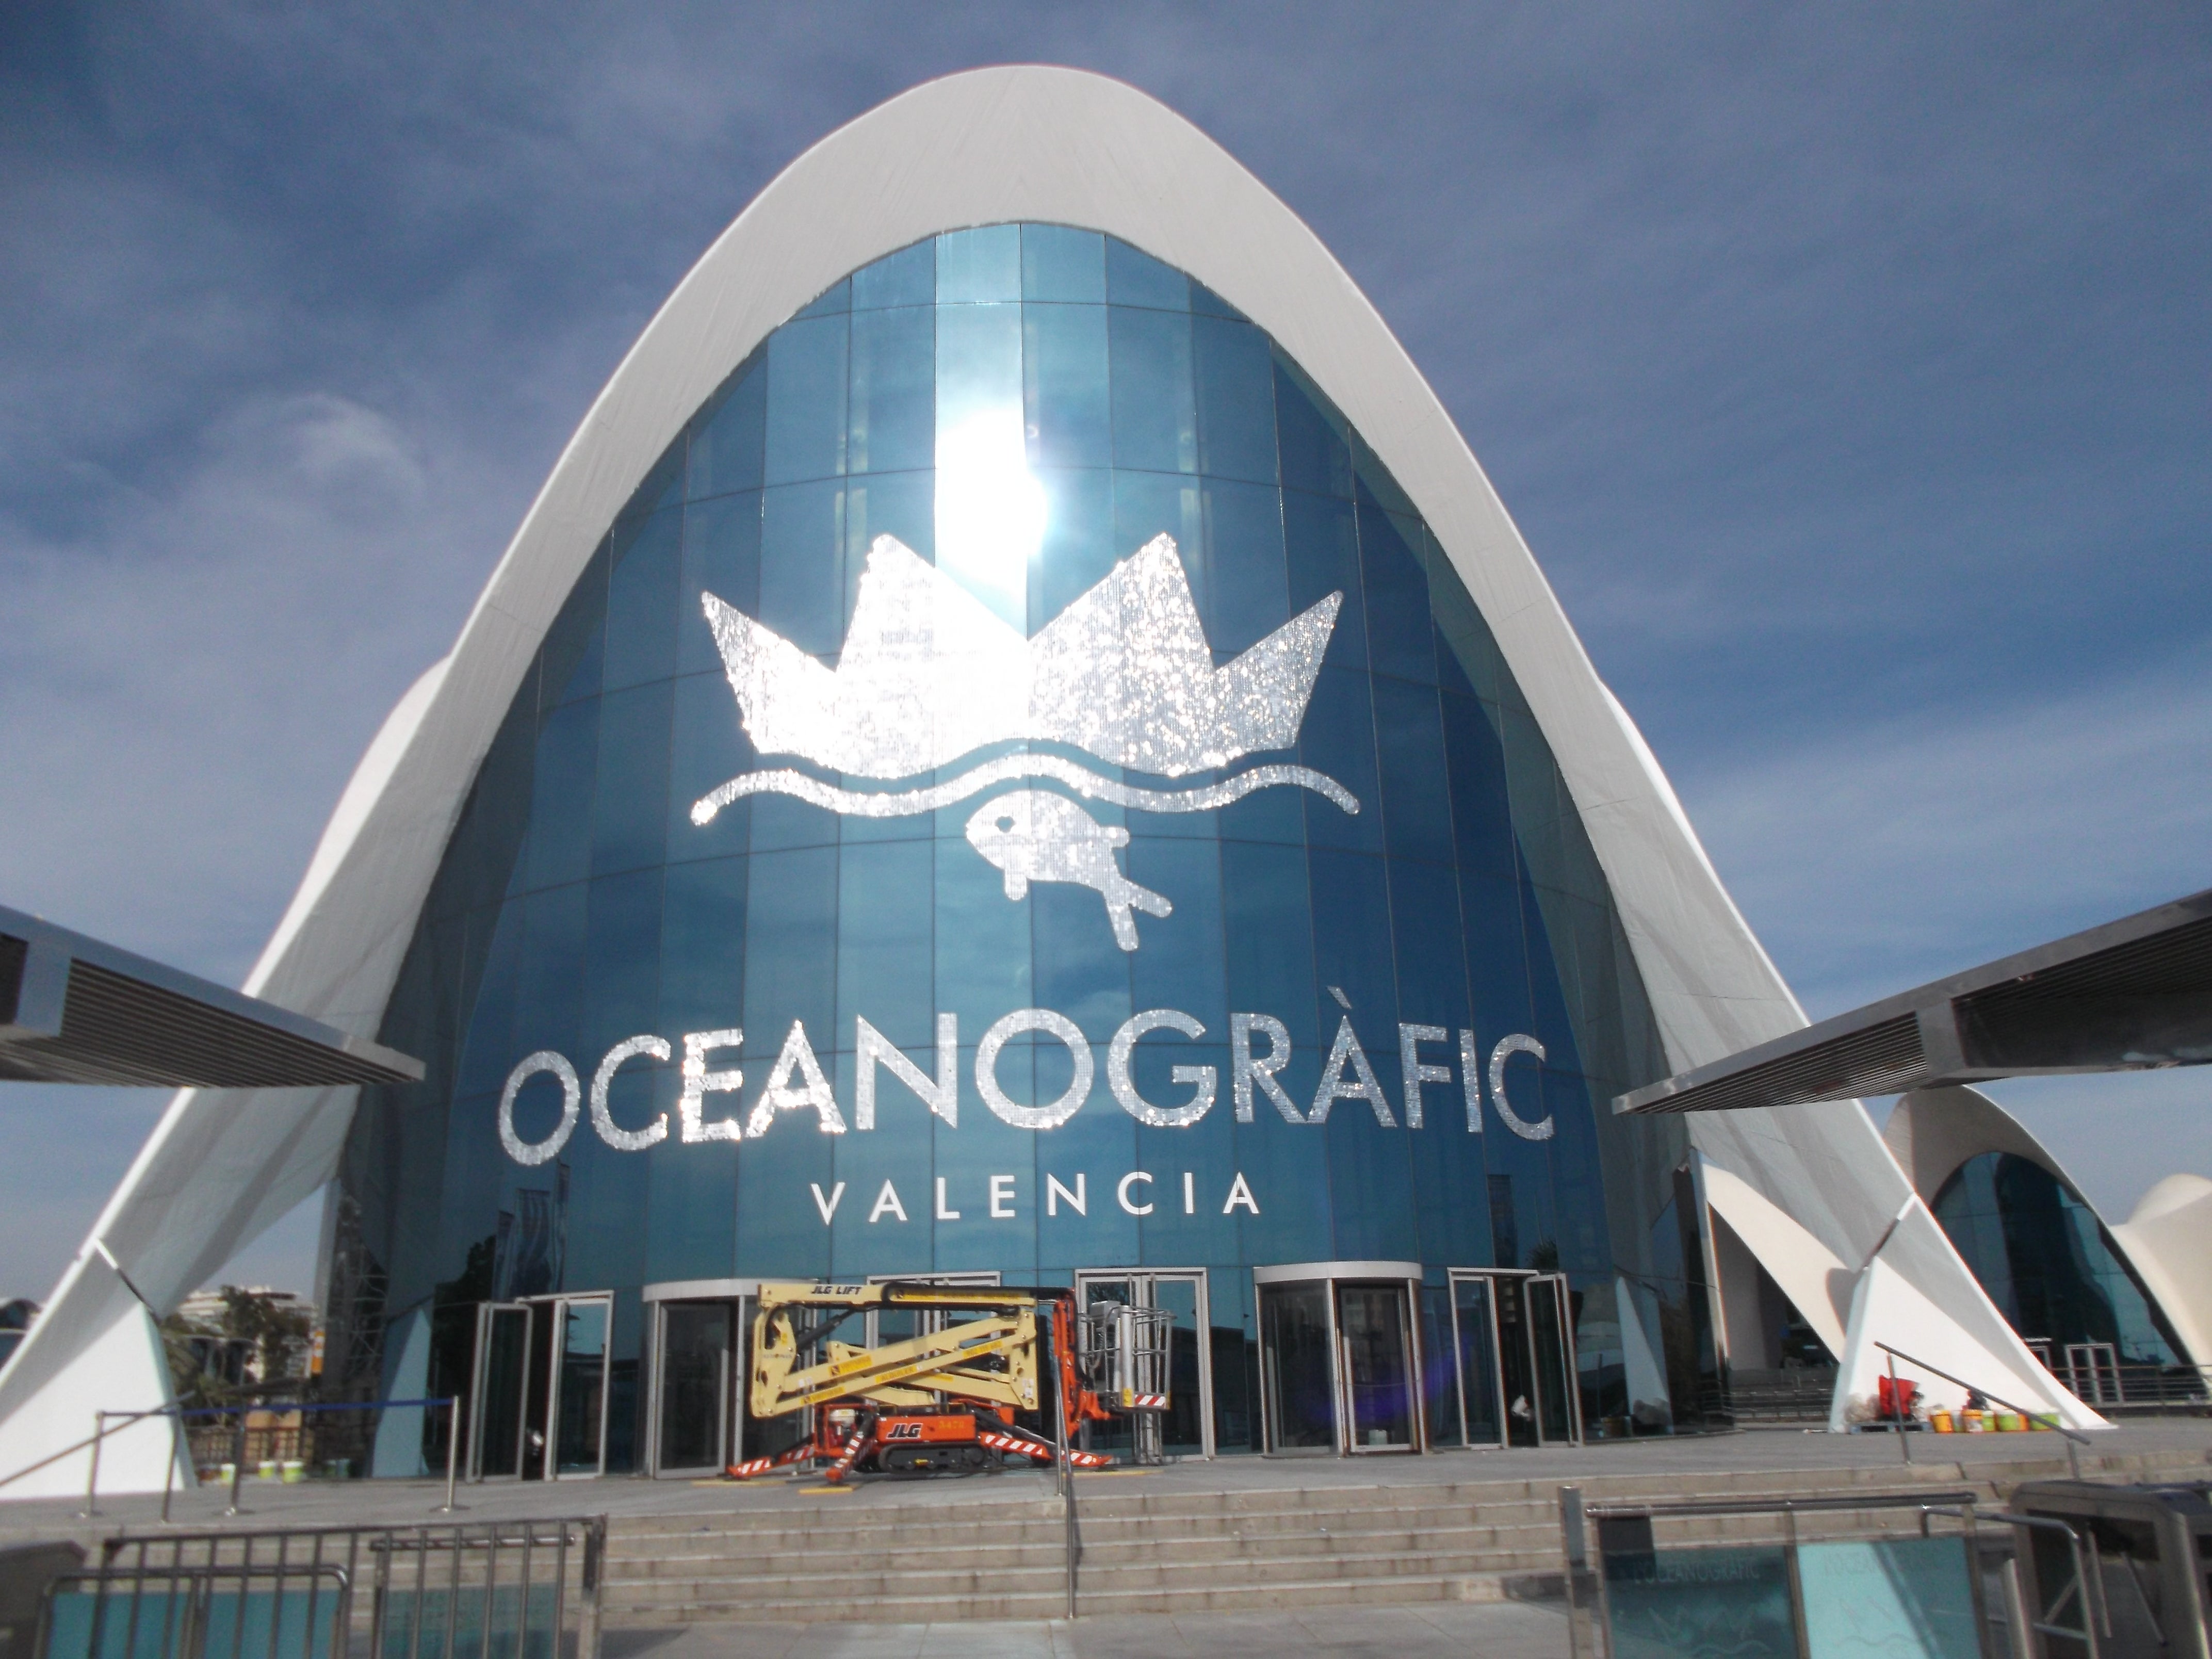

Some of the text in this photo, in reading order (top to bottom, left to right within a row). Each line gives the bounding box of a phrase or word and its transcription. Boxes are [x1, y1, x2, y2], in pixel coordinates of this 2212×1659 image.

[497, 985, 1554, 1166] OCEANOGRÀFIC
[810, 1171, 1260, 1226] VALENCIA
[811, 1285, 862, 1295] JLG LIFT
[886, 1422, 923, 1439] JLG
